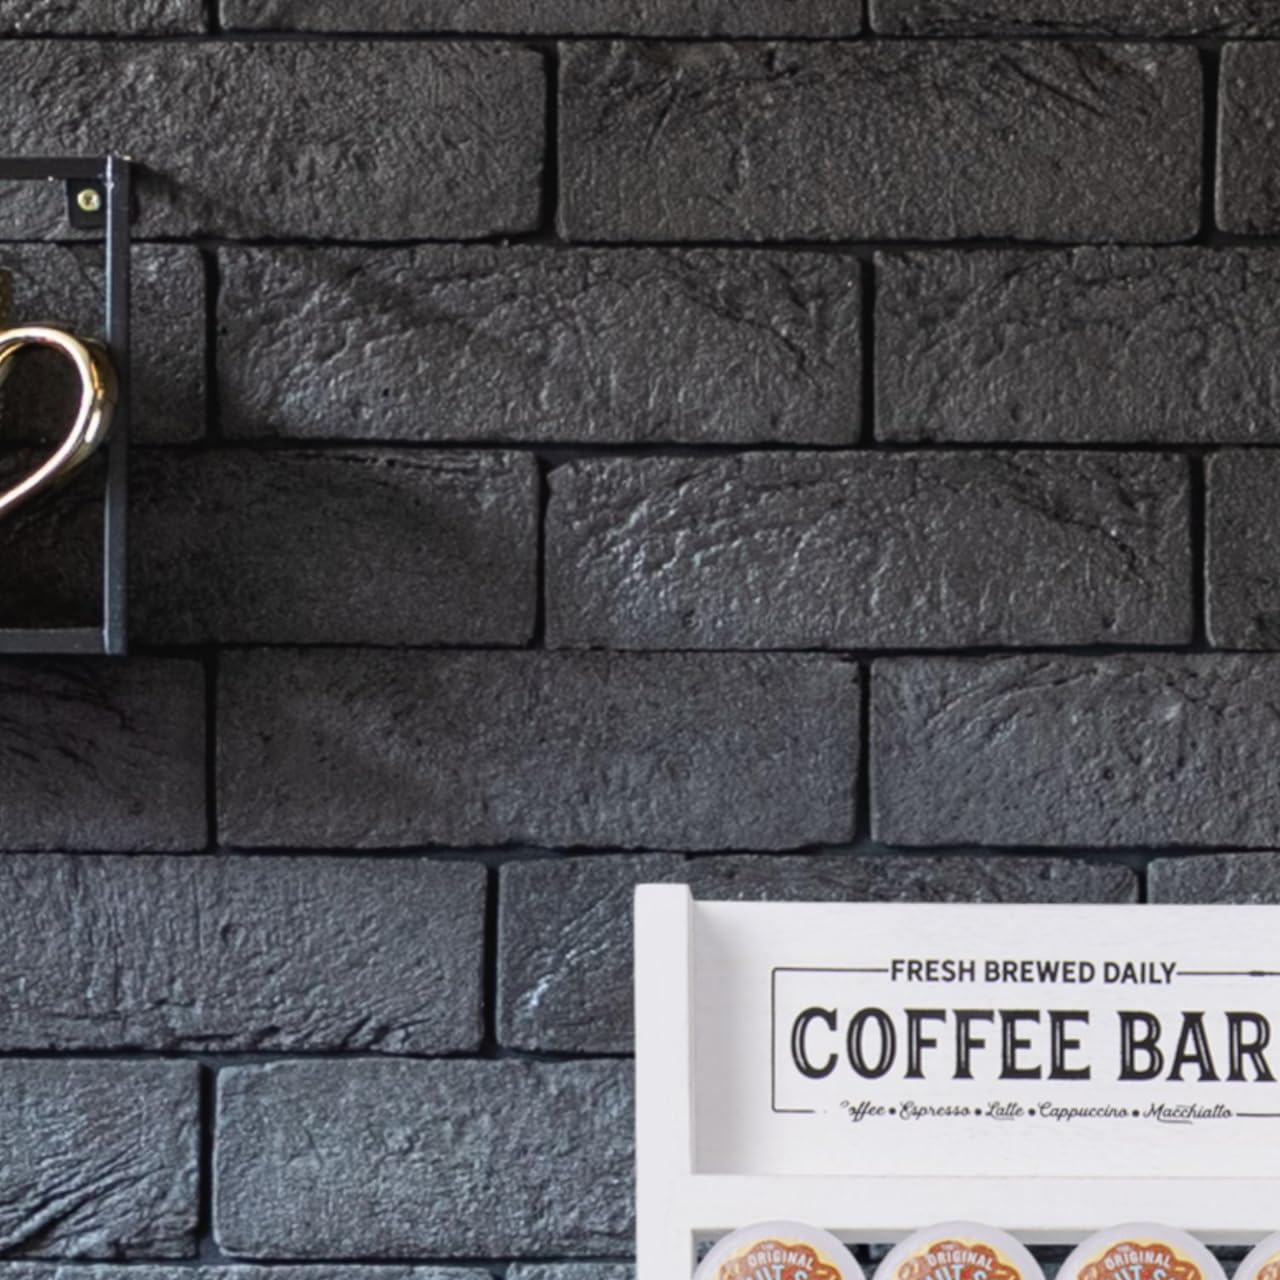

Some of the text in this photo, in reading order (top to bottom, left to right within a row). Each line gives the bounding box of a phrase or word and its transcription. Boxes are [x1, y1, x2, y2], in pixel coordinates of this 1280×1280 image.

[890, 959, 1176, 985] FRESH BREWED DAILY
[791, 1006, 1277, 1082] COFFEE BAR
[899, 1100, 970, 1120] Espresso
[985, 1100, 1024, 1120] Latte
[1037, 1101, 1129, 1122] Cappuccino
[747, 1248, 814, 1271] ORIGINAL
[926, 1248, 993, 1271] ORIGINAL
[1104, 1249, 1171, 1269] ORIGINAL
